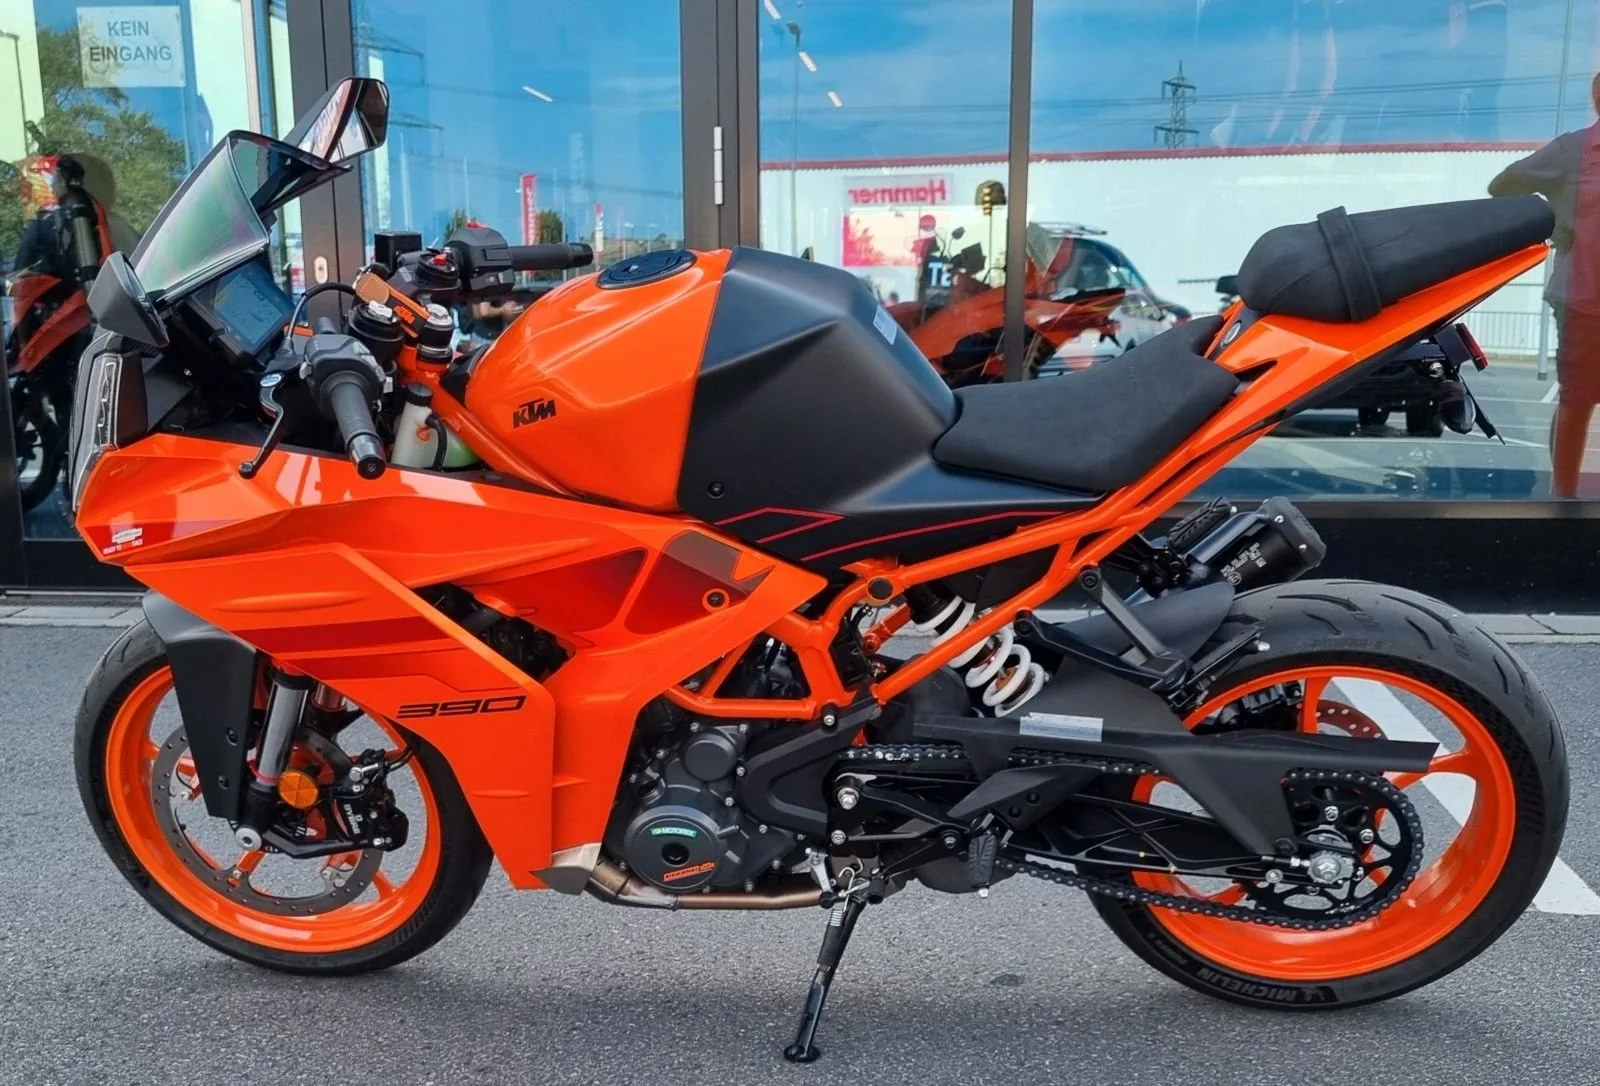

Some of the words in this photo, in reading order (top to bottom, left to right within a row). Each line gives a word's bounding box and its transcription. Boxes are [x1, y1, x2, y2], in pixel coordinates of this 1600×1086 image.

[107, 20, 149, 36] KEIN
[90, 45, 172, 61] EINGANG
[512, 398, 557, 429] KTM
[396, 695, 527, 719] 390
[662, 826, 697, 838] MOTOREX
[1196, 967, 1298, 1001] MICHELIN
